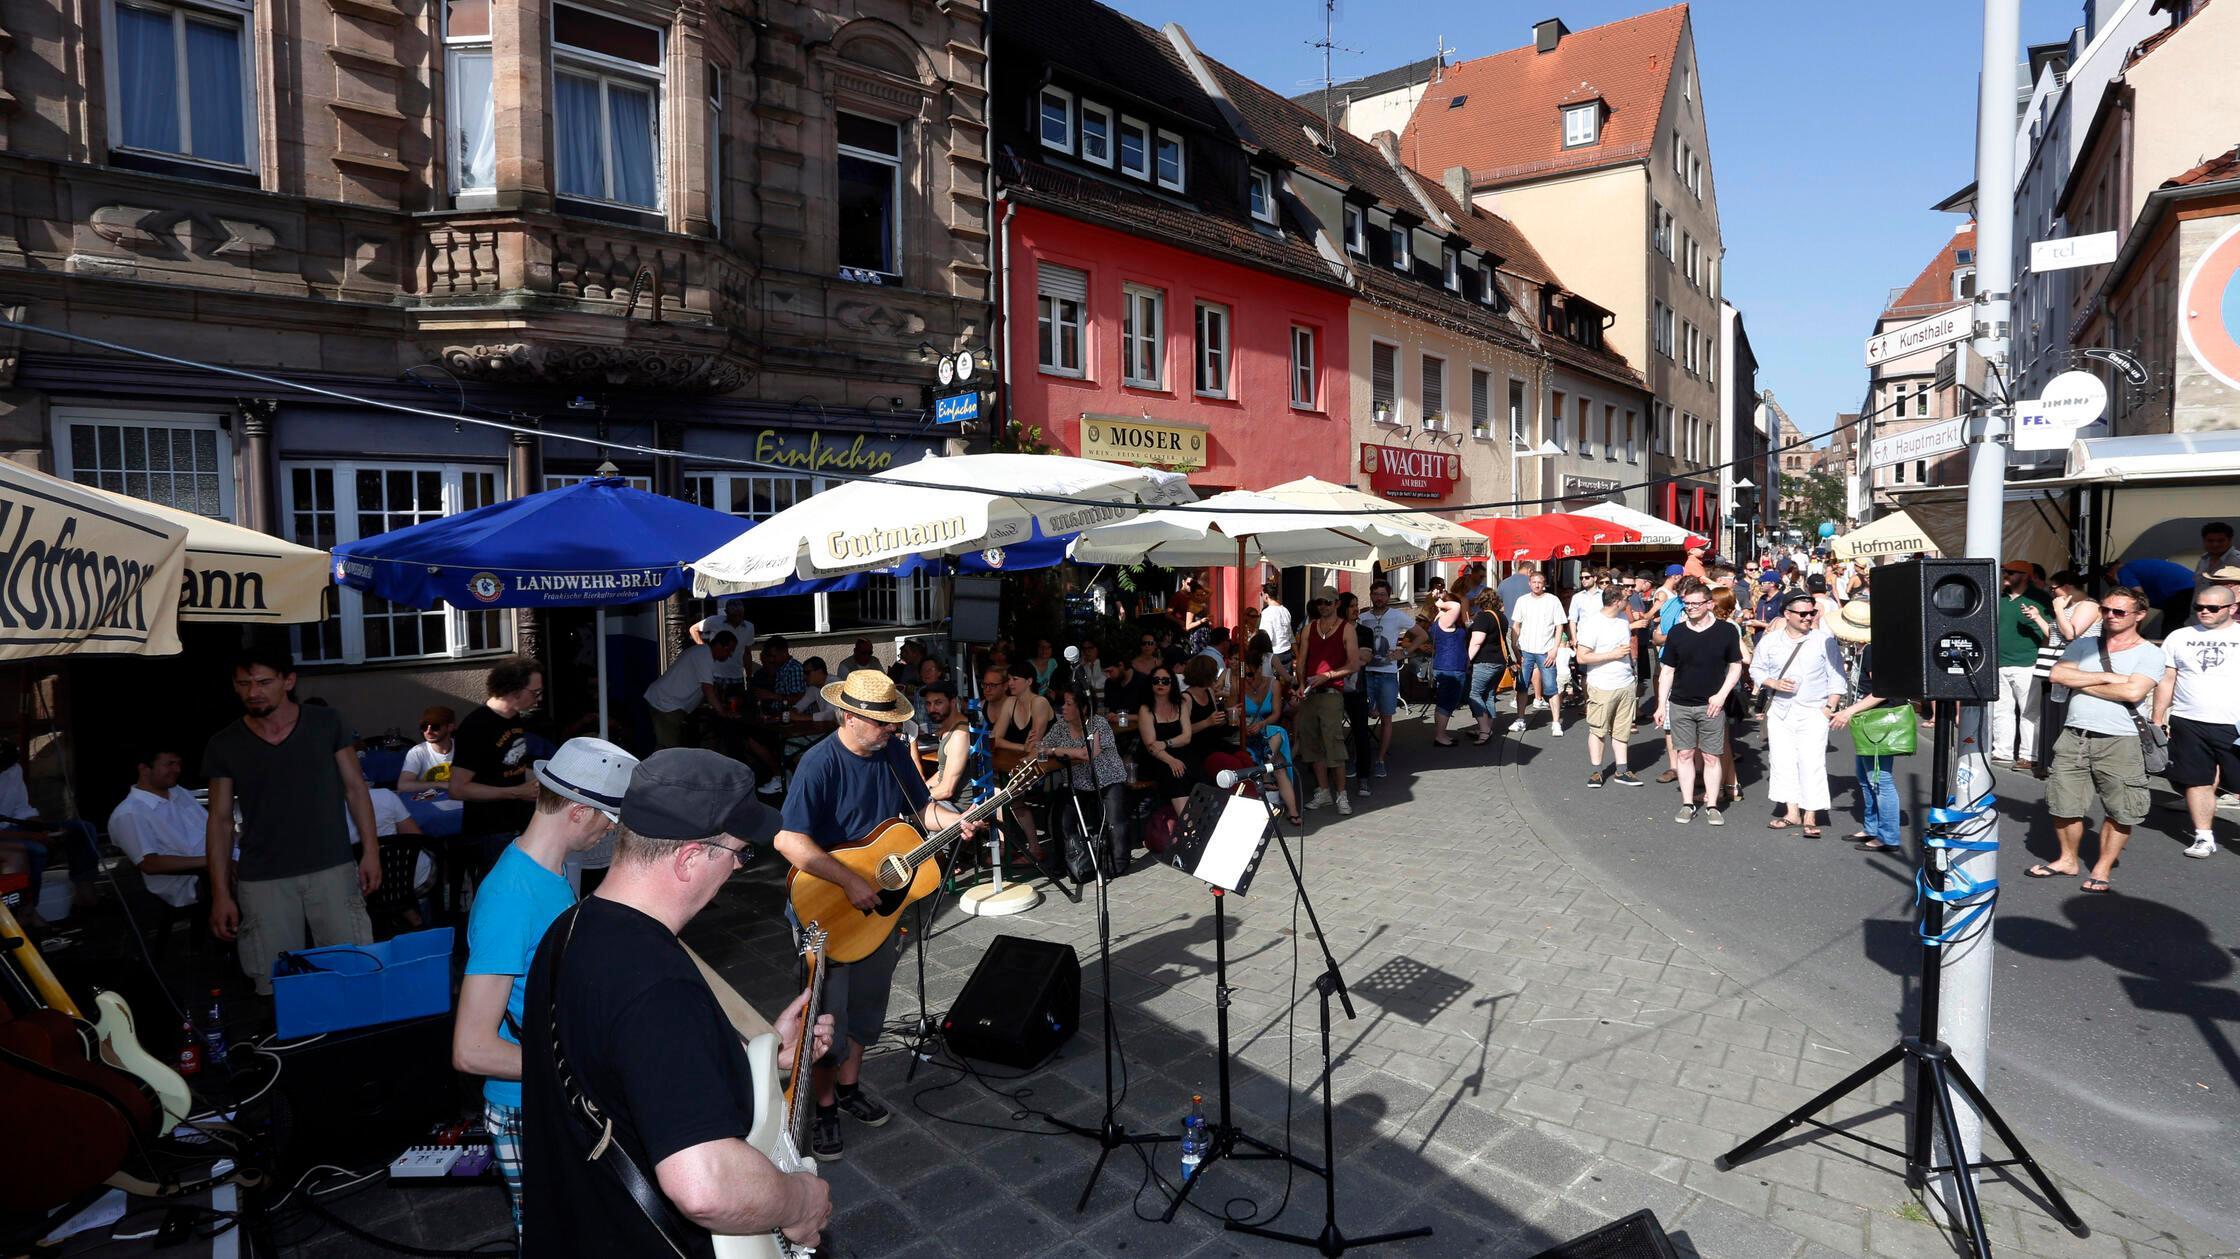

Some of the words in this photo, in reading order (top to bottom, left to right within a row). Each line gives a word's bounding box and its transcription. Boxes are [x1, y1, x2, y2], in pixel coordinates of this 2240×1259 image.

[1900, 320, 1954, 348] Kunsthalle
[2108, 353, 2141, 379] Gasthaus
[938, 398, 978, 420] Einfachso
[755, 430, 892, 471] Einfachso
[1110, 427, 1181, 450] MOSER
[1896, 427, 1958, 455] Hauptmarkt
[1382, 449, 1444, 478] WACHT
[827, 515, 966, 559] Gutmann
[1460, 539, 1486, 555] Hofmann
[1643, 535, 1671, 544] mann
[1852, 538, 1923, 554] Hofmann
[178, 567, 267, 610] ann
[516, 570, 662, 591] LANDWEHR-BRÄU
